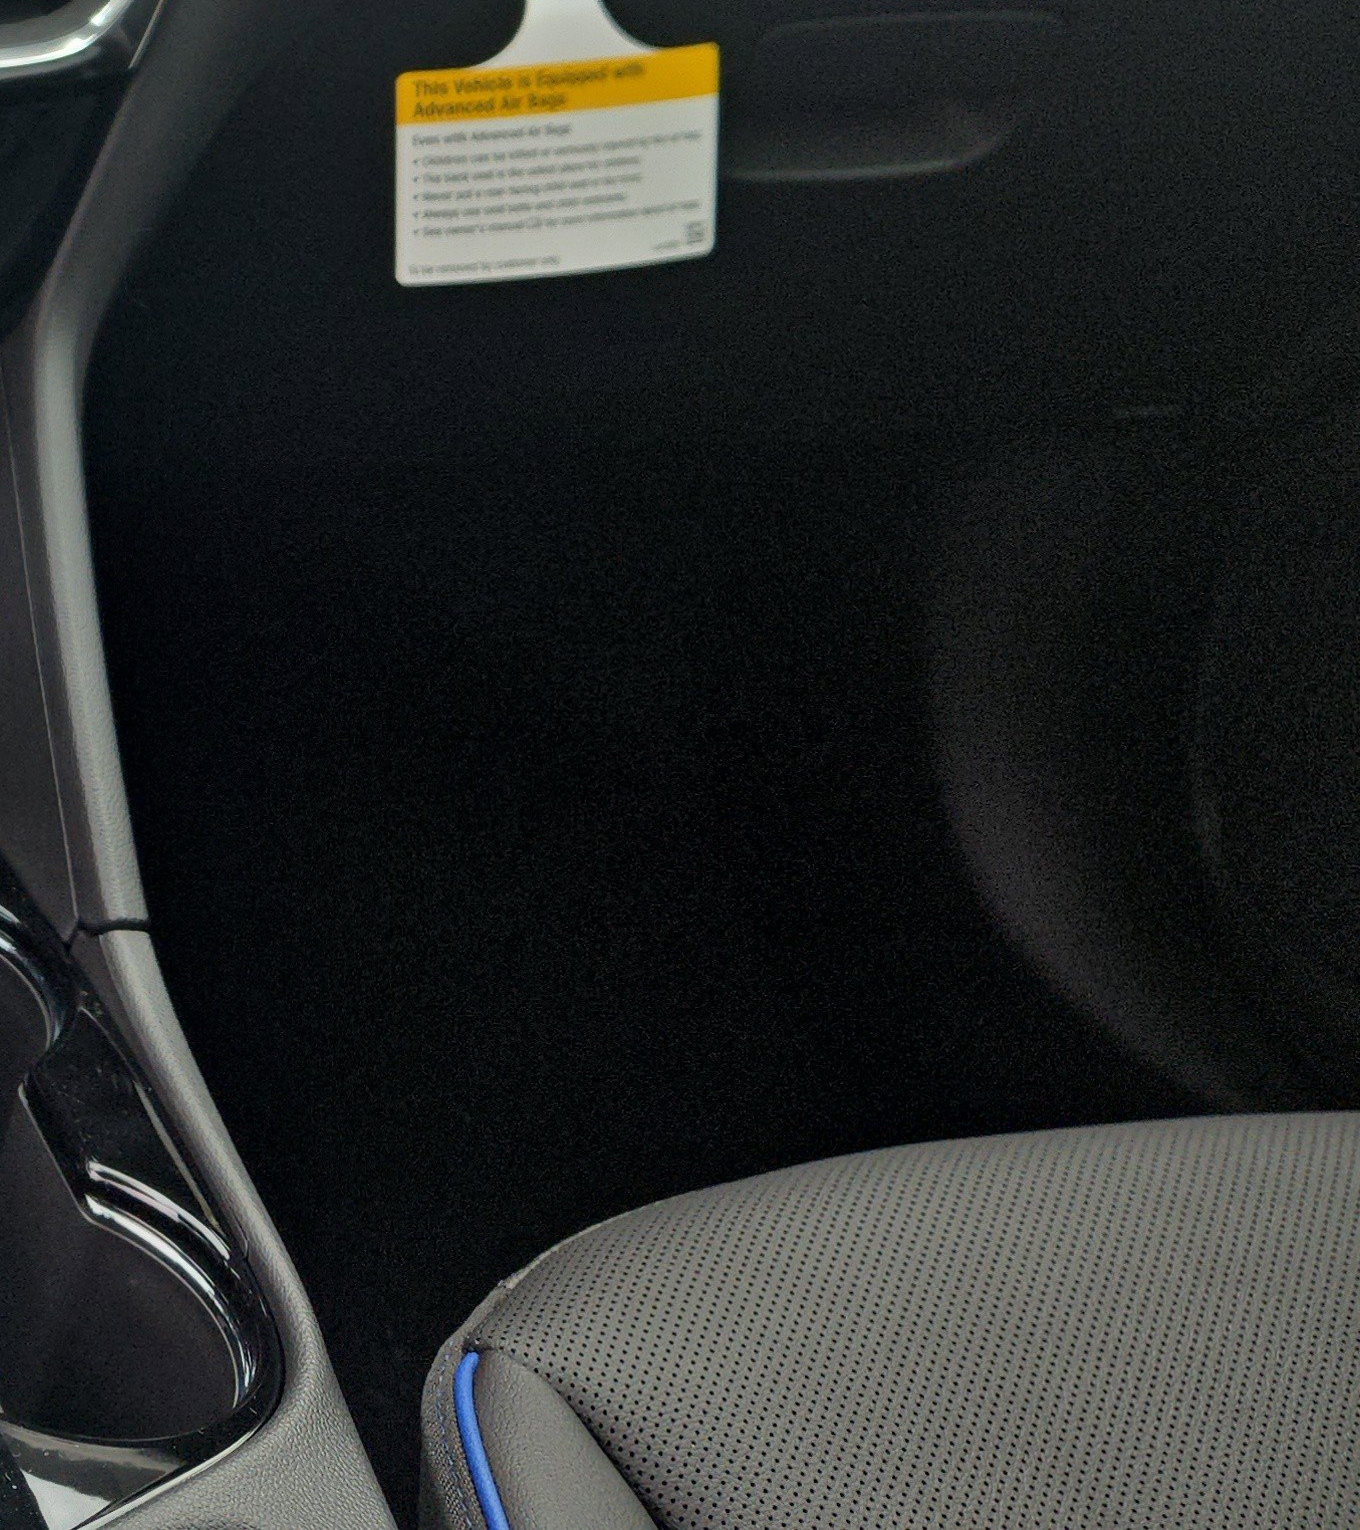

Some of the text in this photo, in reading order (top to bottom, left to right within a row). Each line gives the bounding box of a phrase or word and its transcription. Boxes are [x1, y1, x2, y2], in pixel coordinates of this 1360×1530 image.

[413, 78, 449, 97] This
[454, 75, 513, 94] Vehicle
[413, 97, 496, 118] Advanced
[501, 95, 522, 110] Air
